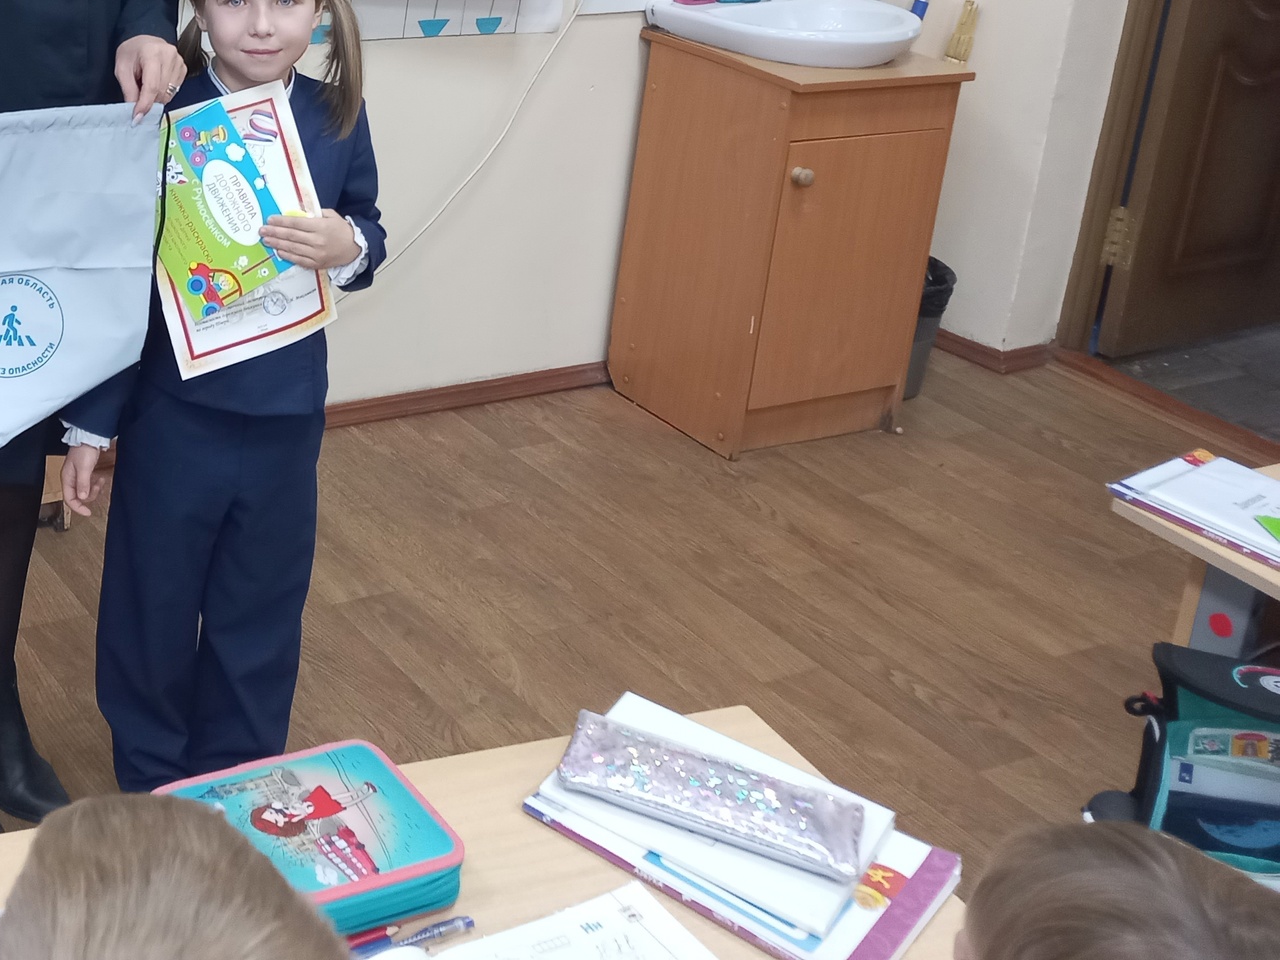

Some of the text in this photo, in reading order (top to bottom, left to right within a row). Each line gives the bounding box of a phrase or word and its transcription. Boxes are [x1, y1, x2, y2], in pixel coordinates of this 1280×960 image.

[205, 181, 241, 233] ДВИЖЕНИЯ
[213, 171, 252, 232] ДОРОЖНОГО
[227, 174, 258, 219] ПРАВИЛА
[169, 188, 213, 264] книжка-раскраска
[17, 277, 55, 309] ОБЛАСТЬ
[8, 342, 55, 375] ОПАСНОСТИ
